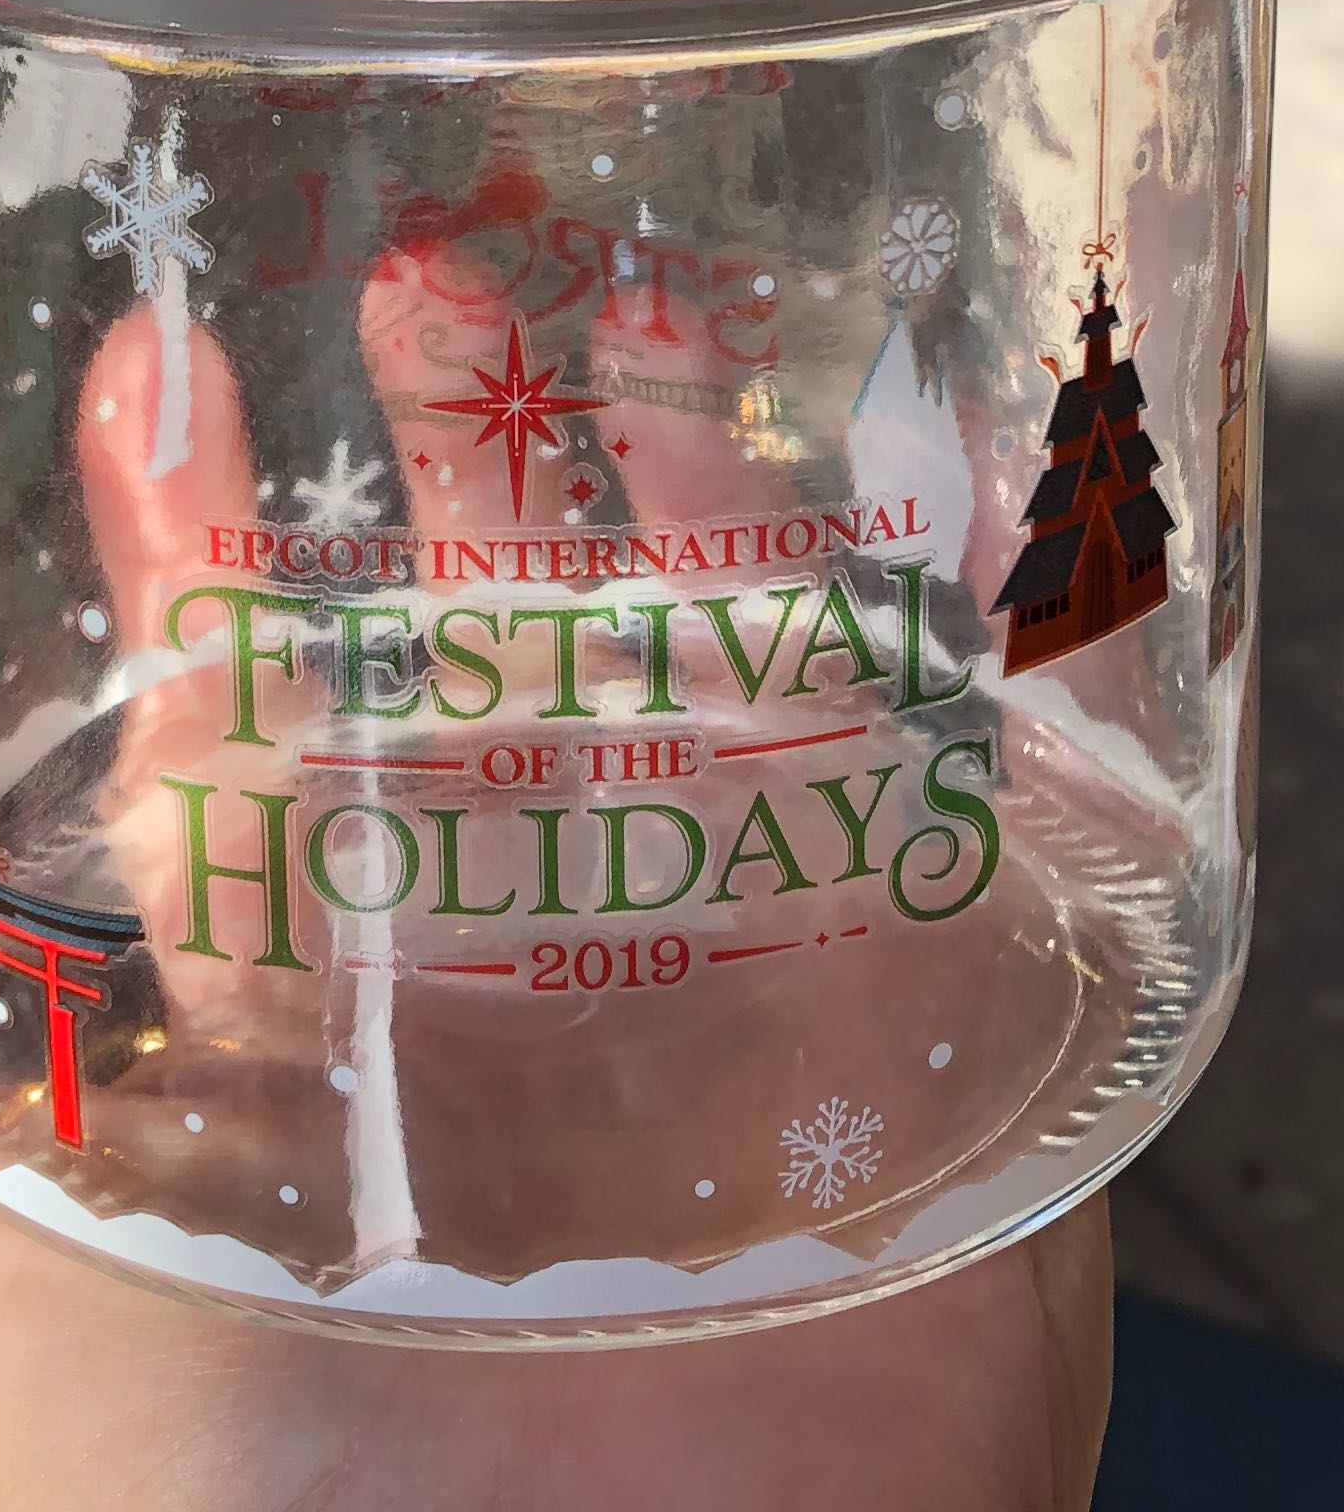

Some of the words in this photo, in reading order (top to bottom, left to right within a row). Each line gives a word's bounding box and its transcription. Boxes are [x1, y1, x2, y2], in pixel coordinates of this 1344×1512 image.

[206, 523, 409, 581] EPCOT
[430, 497, 932, 582] INTERNATIONAL
[164, 558, 978, 747] FESTIVAL
[481, 742, 570, 787] OF
[577, 738, 699, 784] THE
[161, 736, 1002, 974] HOLIDAYS
[528, 935, 692, 992] 2019
